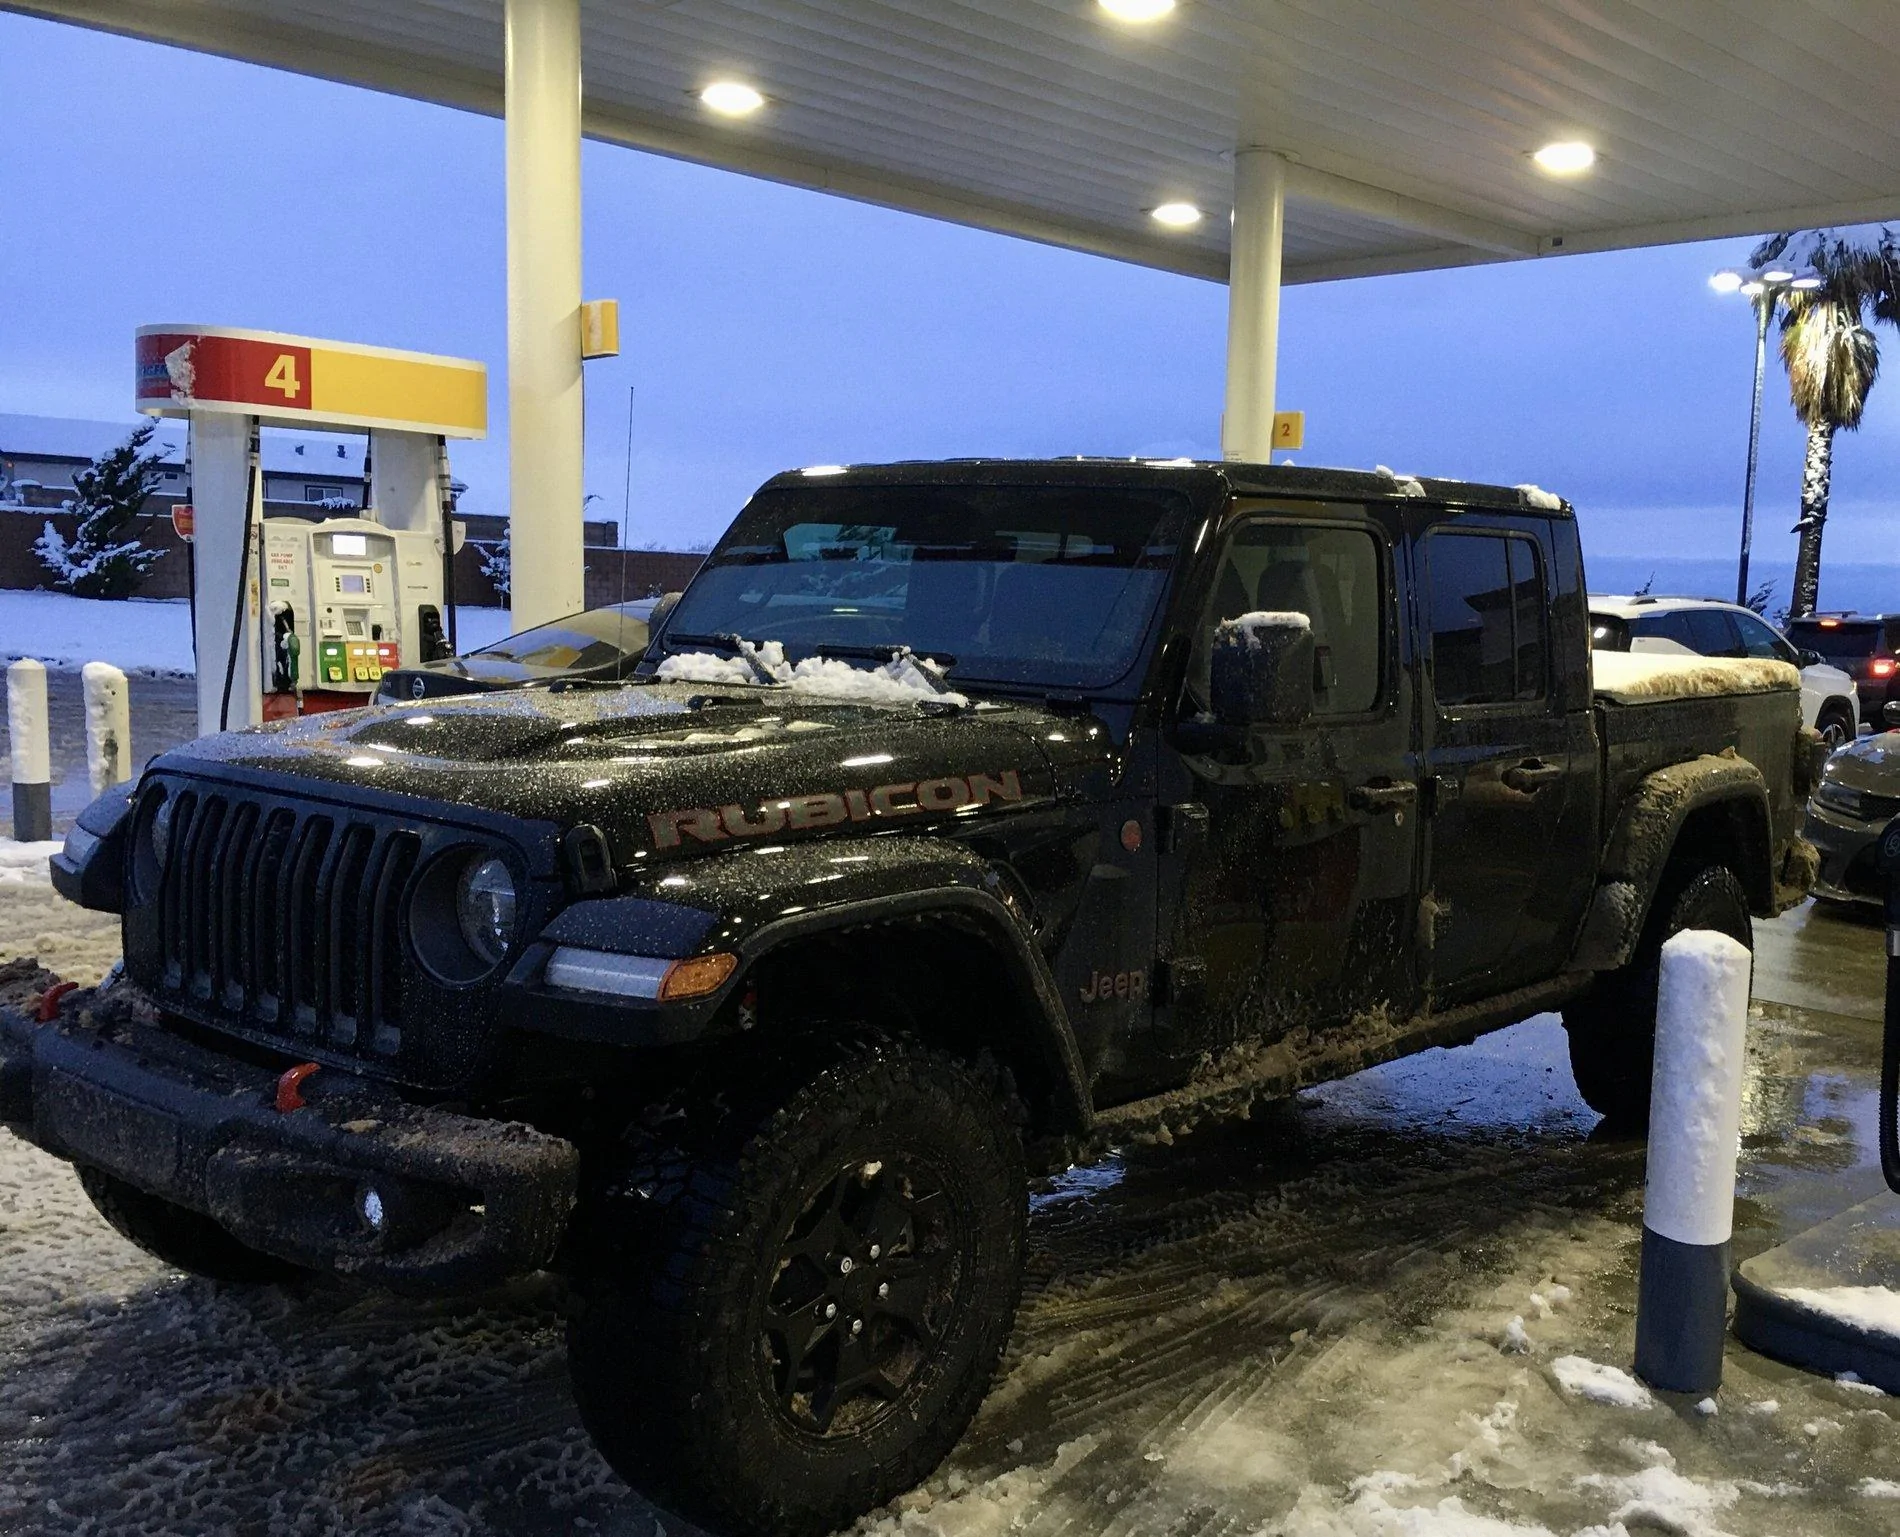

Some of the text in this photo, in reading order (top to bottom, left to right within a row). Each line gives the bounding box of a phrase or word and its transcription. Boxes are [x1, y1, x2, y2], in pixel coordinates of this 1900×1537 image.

[264, 354, 300, 399] 4
[1281, 422, 1290, 437] 2
[648, 770, 1021, 849] RUBICON
[1080, 969, 1147, 1003] Jeep
